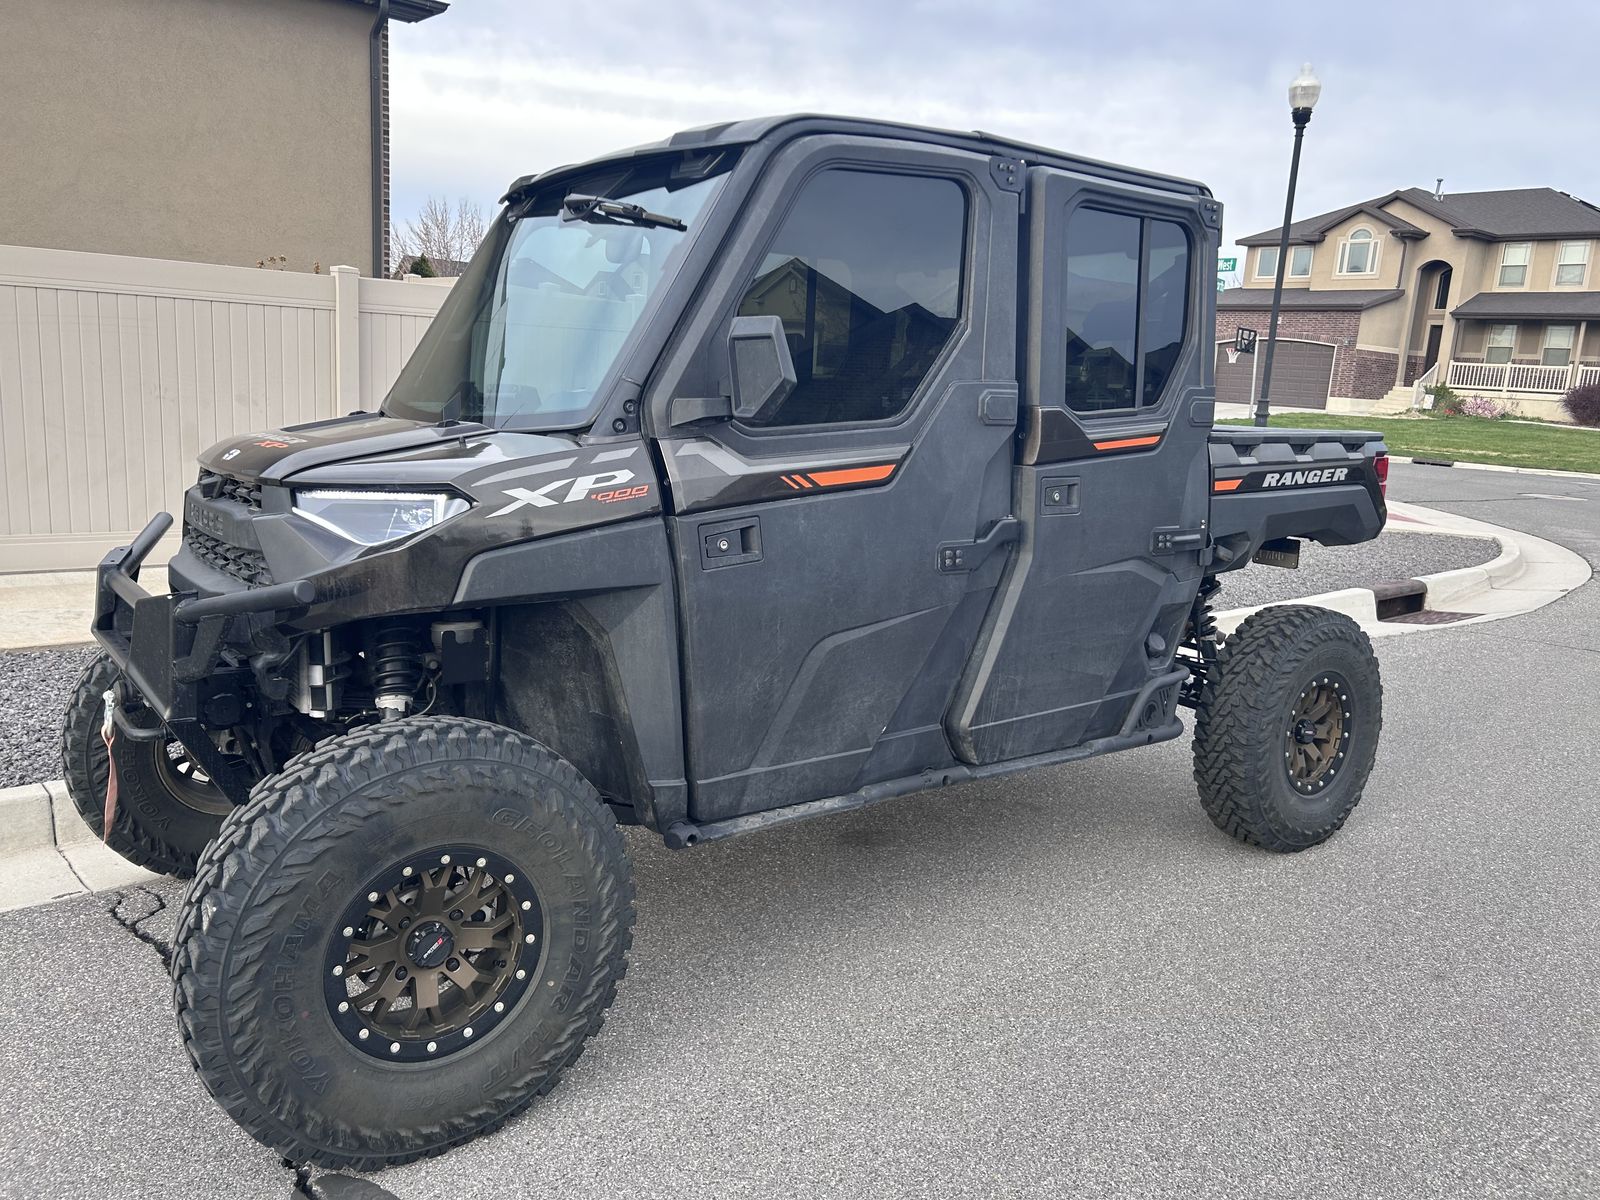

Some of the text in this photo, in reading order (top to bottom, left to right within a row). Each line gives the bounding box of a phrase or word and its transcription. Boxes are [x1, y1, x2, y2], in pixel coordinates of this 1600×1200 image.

[485, 469, 636, 519] XP
[1262, 467, 1348, 488] RANGER
[490, 806, 592, 1014] GEOLANDAR
[271, 868, 344, 1095] YOKOHAMA
